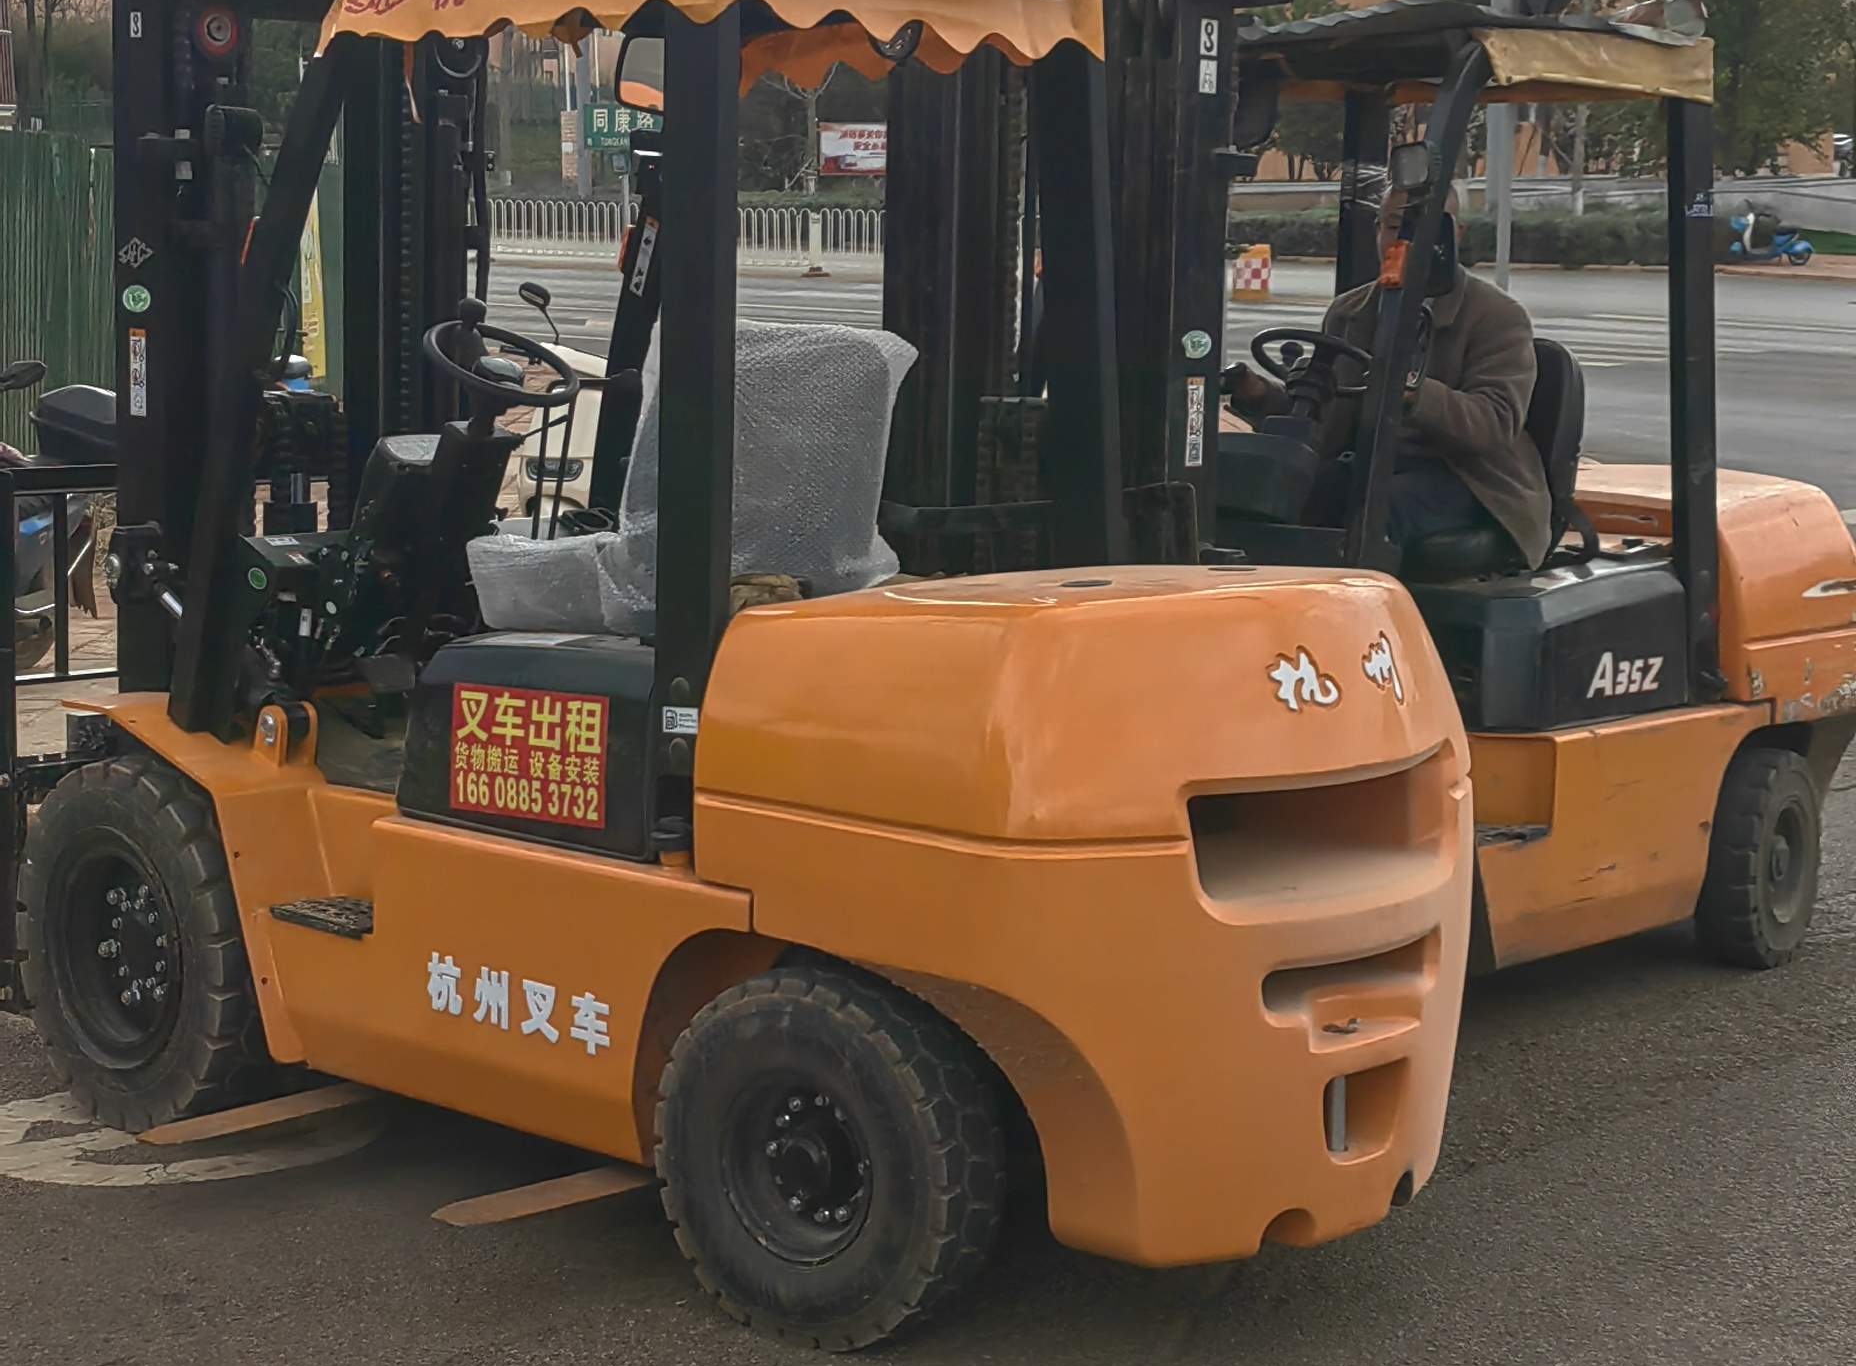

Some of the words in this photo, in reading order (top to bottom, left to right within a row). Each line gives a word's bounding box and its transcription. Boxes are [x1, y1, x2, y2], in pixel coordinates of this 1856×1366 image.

[593, 107, 654, 133] 同康路
[1586, 651, 1664, 699] A35Z
[456, 690, 602, 754] 叉车出租
[454, 742, 520, 775] 货物搬运
[529, 750, 600, 785] 设备安装
[456, 771, 490, 806] 166
[495, 775, 542, 813] 0885
[548, 784, 599, 821] 3732
[427, 951, 610, 1055] 杭州叉车
